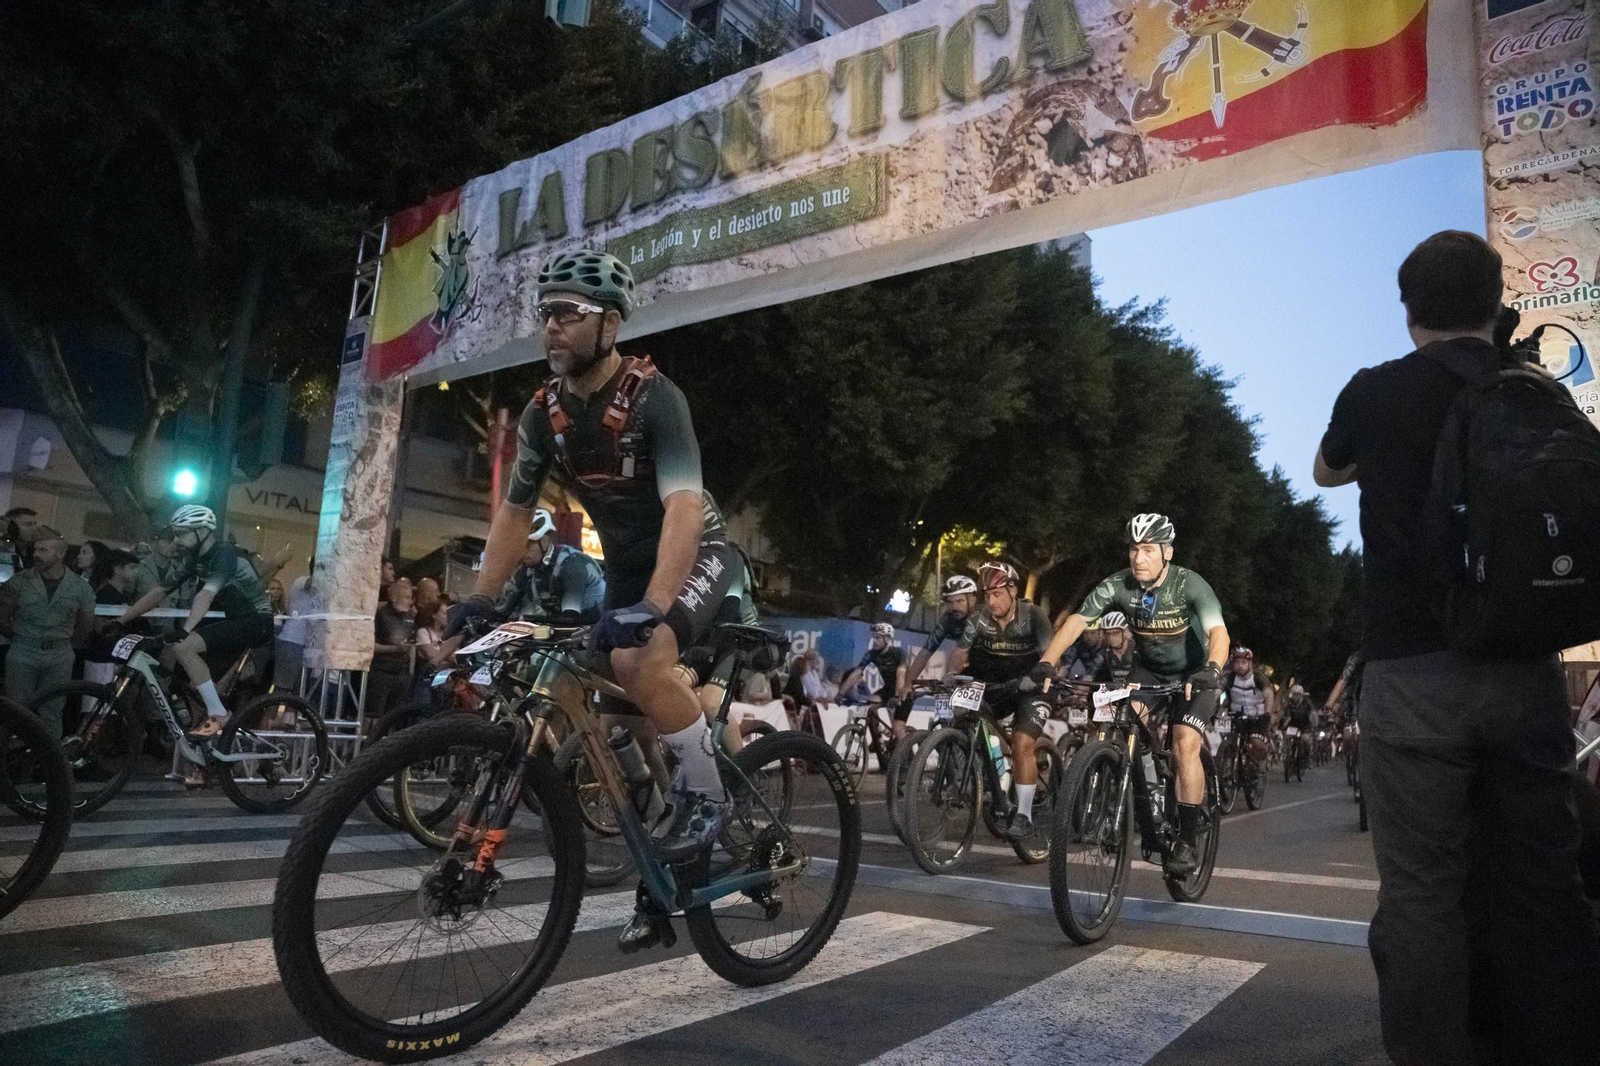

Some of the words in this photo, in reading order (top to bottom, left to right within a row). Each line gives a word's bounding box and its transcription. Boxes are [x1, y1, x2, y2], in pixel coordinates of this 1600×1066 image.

[1489, 13, 1590, 63] Coca-Cola
[1496, 63, 1587, 95] GRUPO
[1497, 77, 1592, 115] RENTA
[497, 170, 568, 262] LA
[583, 0, 1094, 228] DESÉRTICA
[1498, 98, 1593, 136] TODO
[631, 246, 644, 265] La
[651, 228, 683, 258] Legión
[692, 229, 702, 248] y
[709, 219, 721, 241] el
[729, 205, 782, 236] desierto
[790, 196, 814, 218] nos
[822, 186, 850, 208] une
[386, 1032, 460, 1051] MAXXIS
